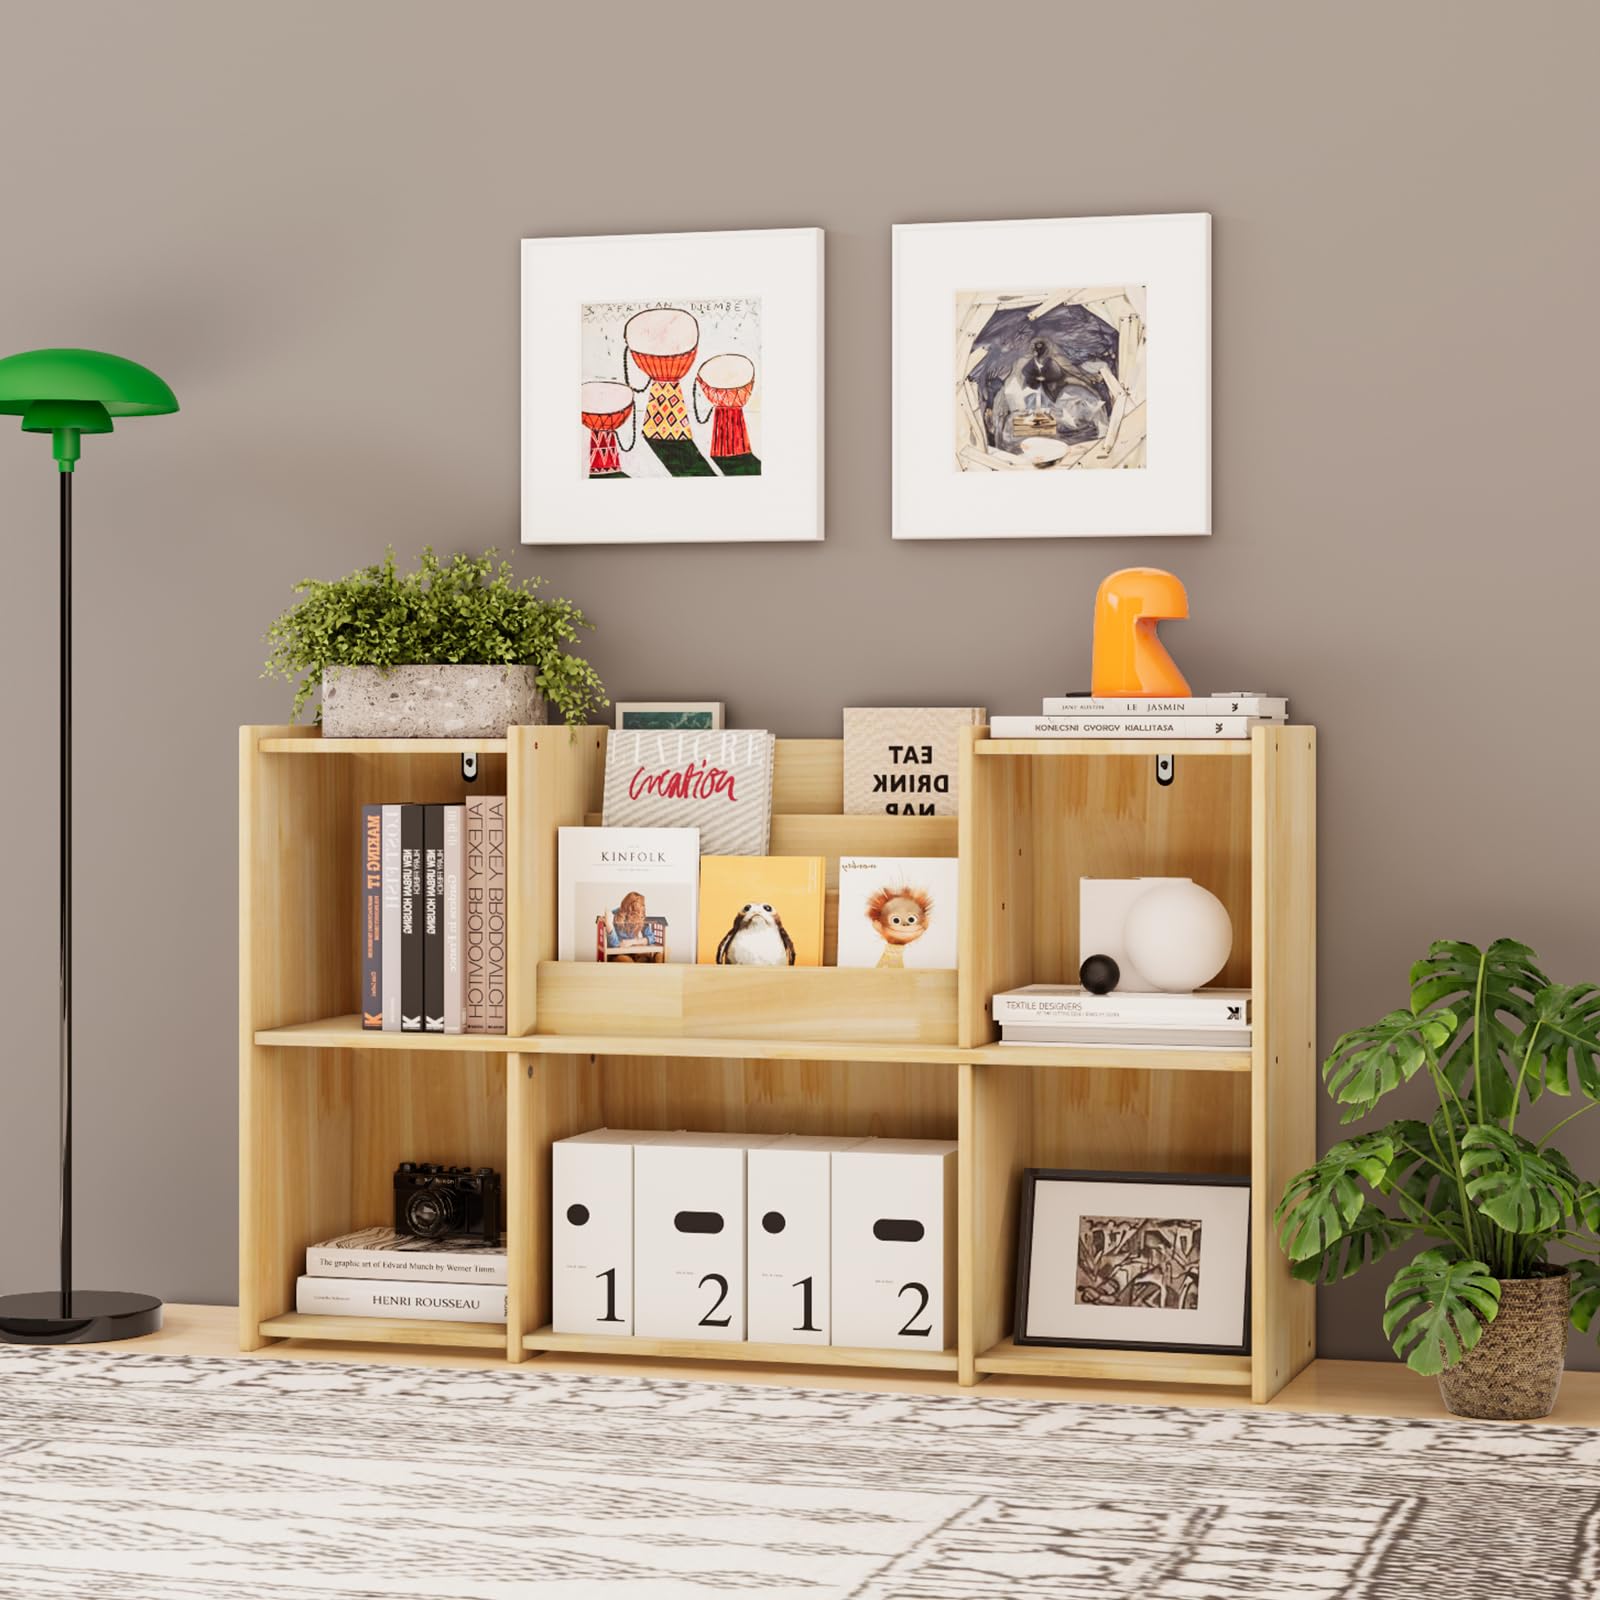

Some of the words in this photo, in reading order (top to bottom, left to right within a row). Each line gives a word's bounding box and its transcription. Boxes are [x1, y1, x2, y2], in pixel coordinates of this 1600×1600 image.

[1126, 703, 1138, 711] LE
[1146, 703, 1186, 712] JASMIN
[1035, 724, 1080, 732] KONECSNI
[1083, 724, 1121, 732] GYORGY
[1124, 724, 1174, 732] KIALLITASA
[601, 851, 667, 863] KINFOLK
[1006, 1001, 1037, 1010] TEXTILE
[1039, 1002, 1082, 1011] DESIGNERS
[319, 1258, 333, 1266] The
[334, 1259, 360, 1269] graphic
[373, 1260, 382, 1268] of
[382, 1261, 408, 1270] Edvard
[409, 1262, 434, 1271] Munch
[435, 1263, 444, 1273] by
[446, 1264, 472, 1273] Werner
[474, 1264, 496, 1273] Timm
[595, 1267, 625, 1322] 1
[698, 1273, 732, 1327] 2
[373, 1295, 411, 1306] HENRI
[415, 1296, 480, 1309] ROUSSEAU
[792, 1275, 823, 1332] 1
[898, 1282, 933, 1337] 2
